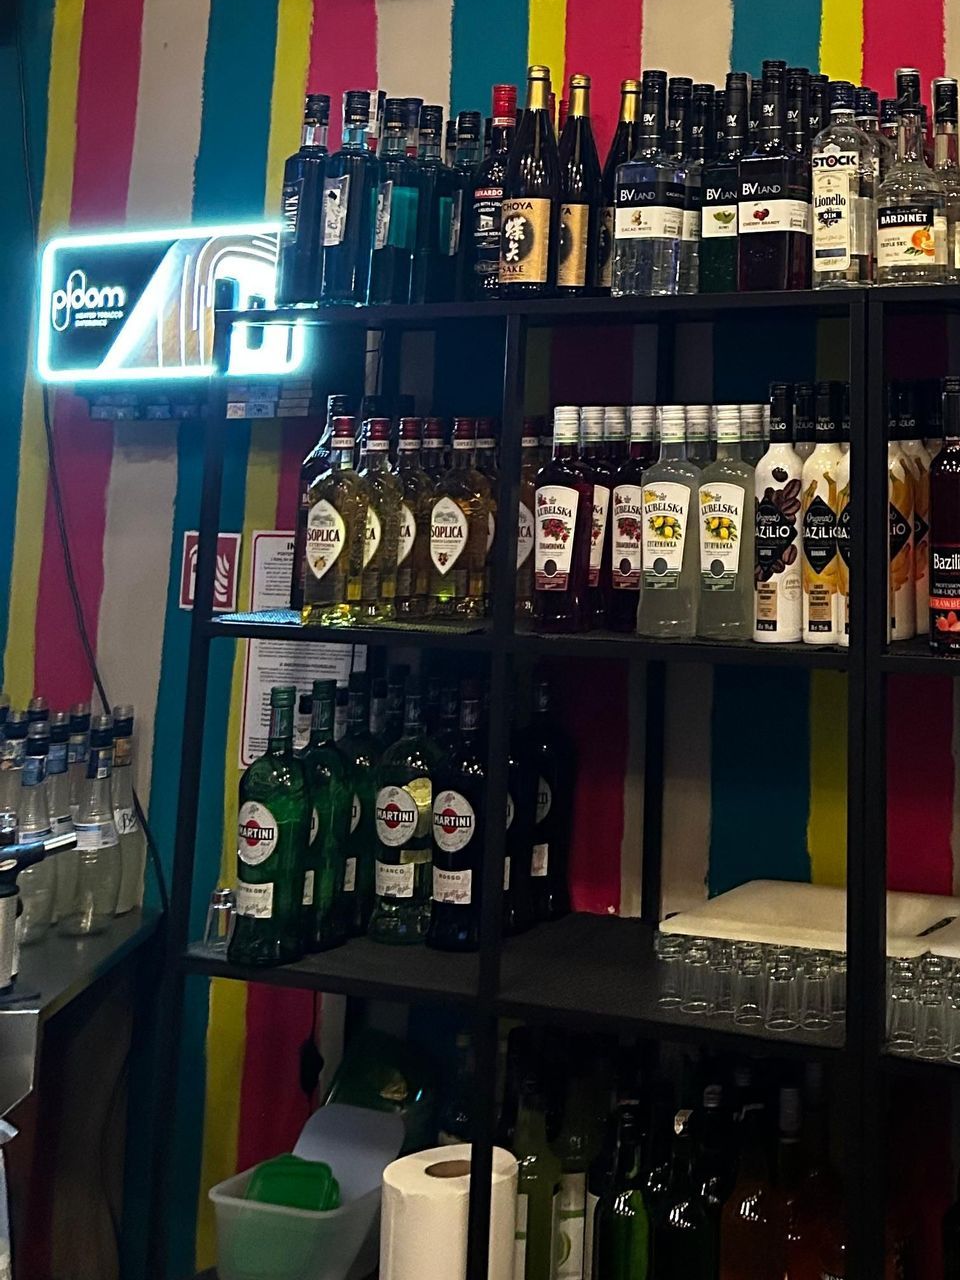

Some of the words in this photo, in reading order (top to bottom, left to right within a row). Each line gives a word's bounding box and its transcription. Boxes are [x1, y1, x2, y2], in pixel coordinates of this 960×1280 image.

[812, 155, 857, 168] STOCK
[503, 202, 534, 212] CHOYA
[814, 193, 846, 208] Lionello
[881, 213, 928, 225] BARDINET
[537, 505, 572, 517] LUBELSKA
[645, 503, 684, 515] LUBELSKA
[701, 504, 738, 516] LUBELSKA
[307, 528, 340, 542] SOPLICA
[430, 525, 463, 538] SOPLICA
[377, 809, 414, 822] MARTINI
[434, 814, 471, 827] MARTINI
